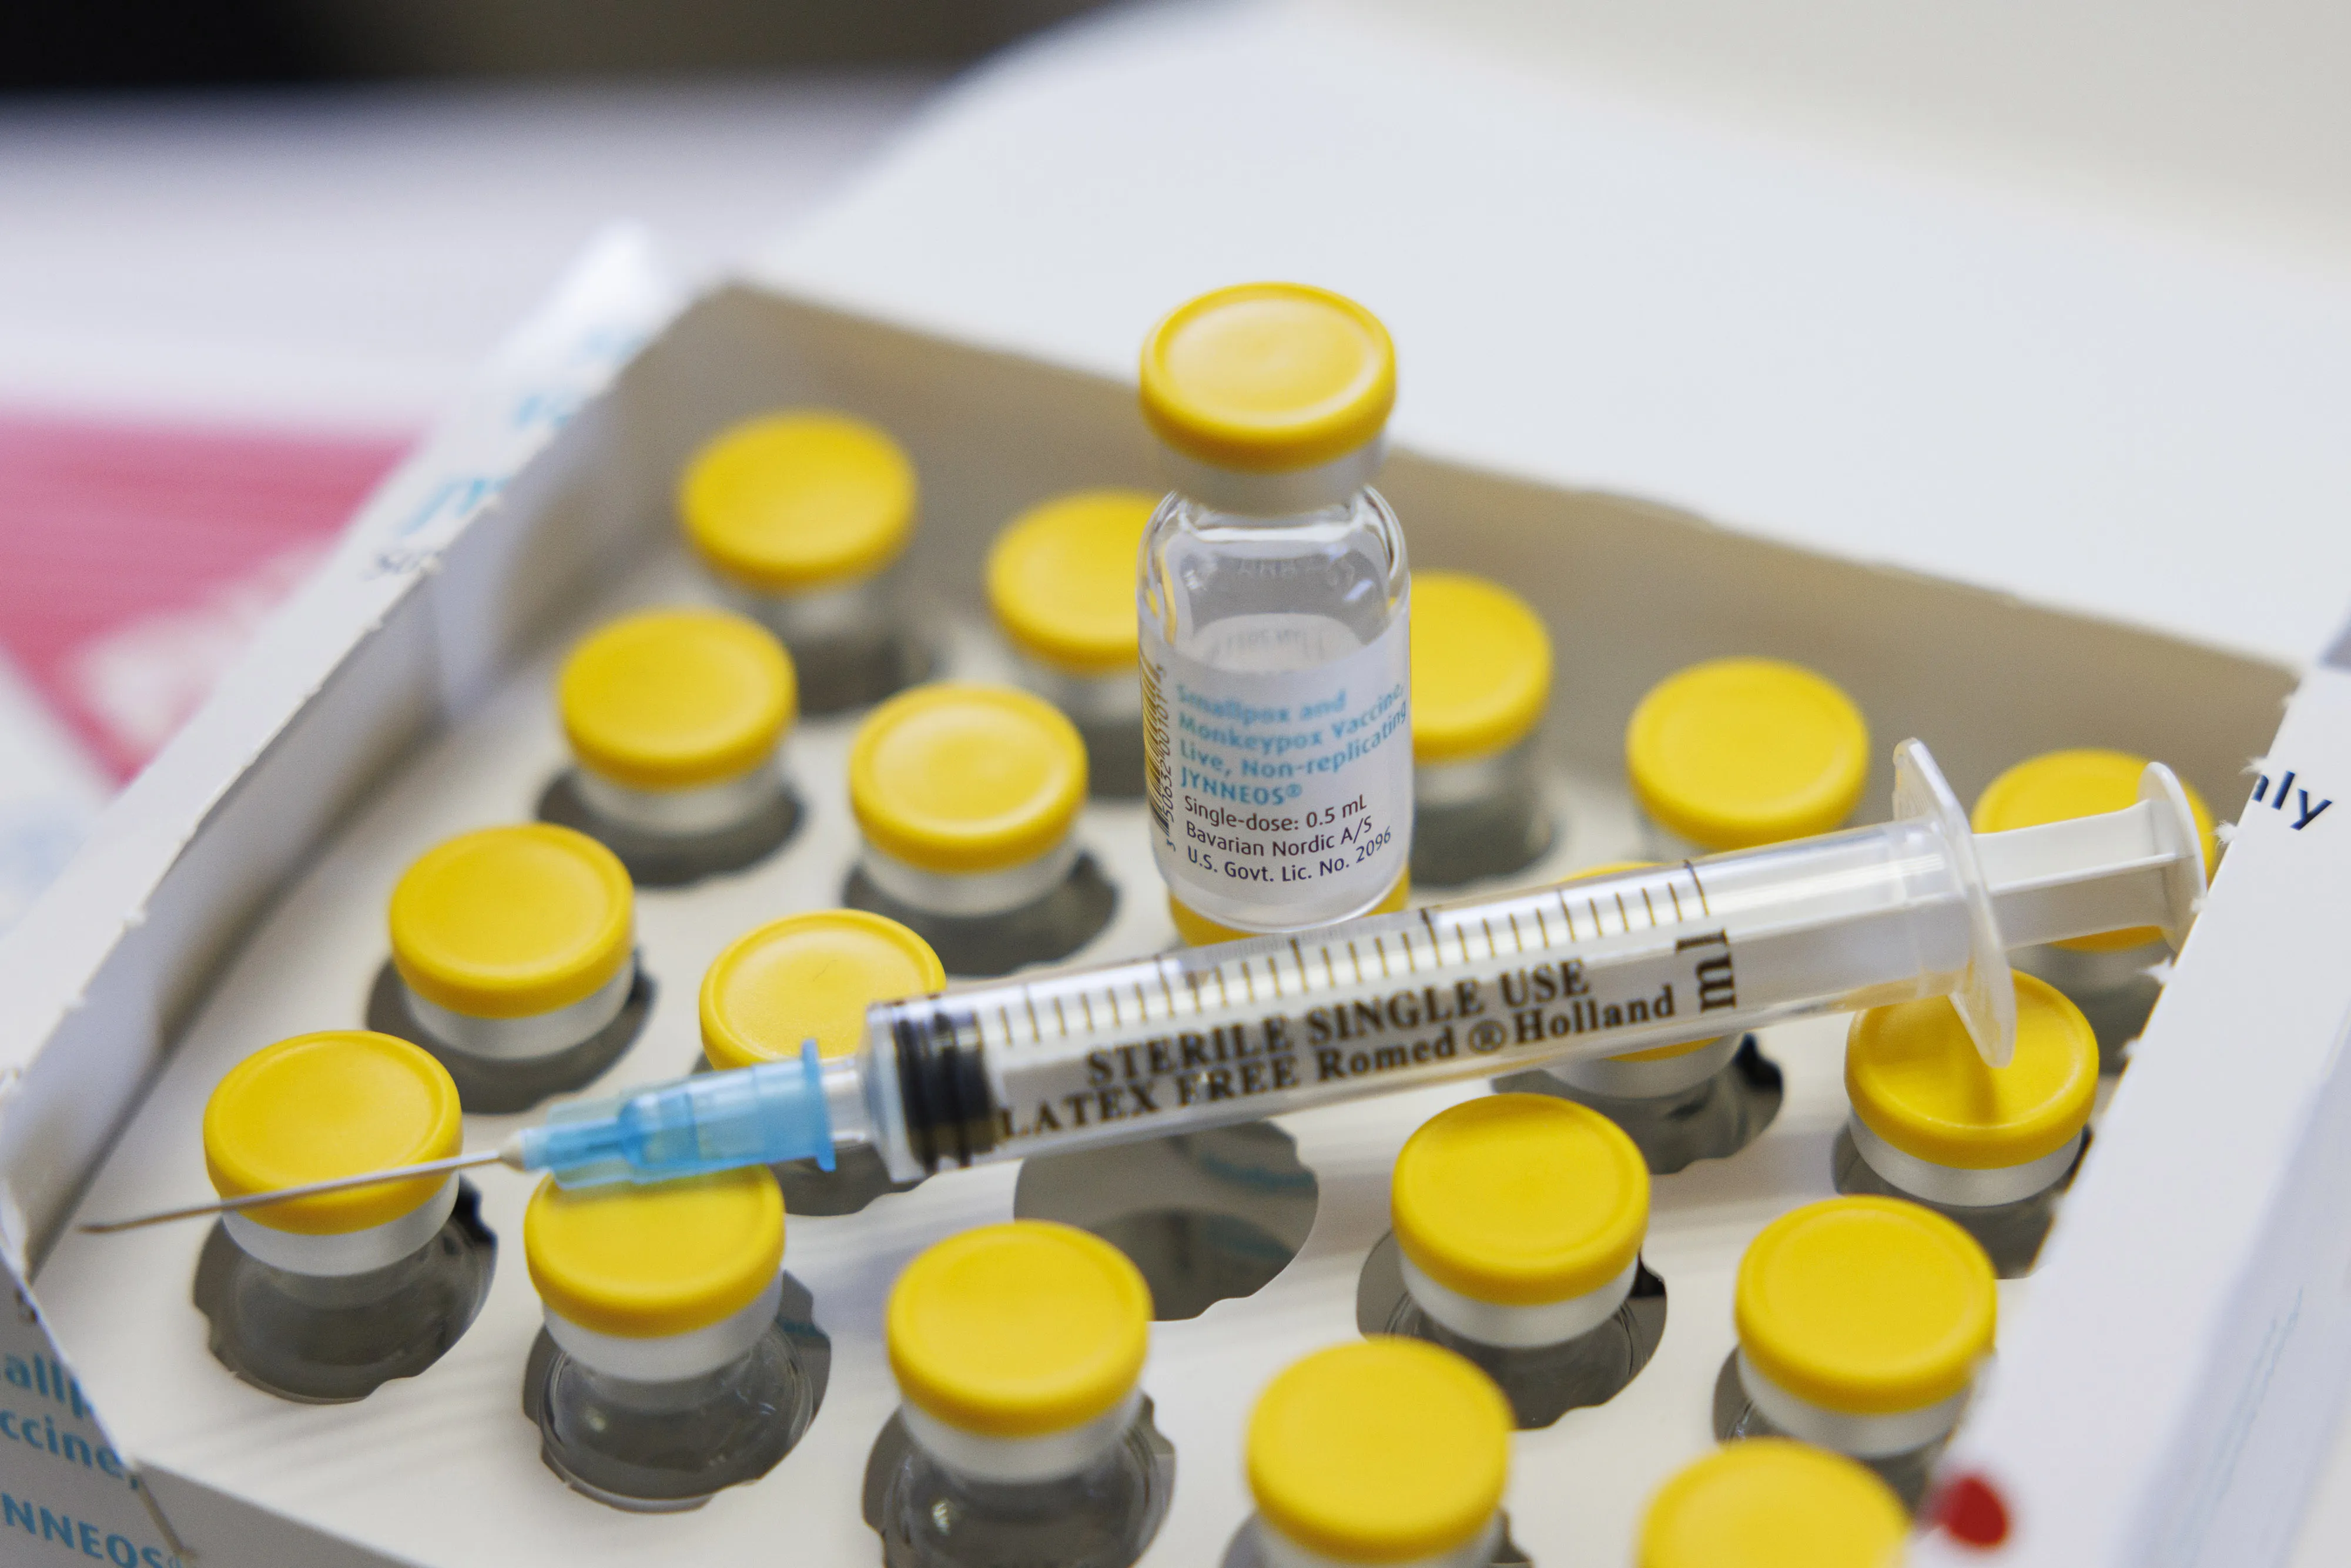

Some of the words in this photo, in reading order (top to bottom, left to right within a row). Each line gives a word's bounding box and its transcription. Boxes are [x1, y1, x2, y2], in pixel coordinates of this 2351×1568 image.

[1177, 685, 1290, 727] Smallpox
[1300, 689, 1347, 721] and
[1179, 712, 1322, 755] Monkeypox
[1180, 739, 1232, 778] Live,
[1242, 701, 1406, 778] Non-replicating
[1184, 795, 1299, 832] Single-dose:
[1306, 806, 1335, 828] 0.5
[1342, 794, 1367, 819] mL
[1186, 820, 1264, 857] Bavarian
[1272, 834, 1335, 857] Nordic
[1341, 815, 1372, 845] A/S
[1187, 845, 1218, 873] U.S.
[1224, 861, 1274, 882] Govt.
[1282, 864, 1312, 882] Lic.
[1319, 858, 1349, 877] No.
[1355, 825, 1391, 863] 2096
[1675, 927, 1737, 1013] ml
[1087, 1013, 1293, 1087] STERILE
[1306, 977, 1486, 1046] SINGLE
[1499, 957, 1589, 1008] USE
[1000, 1081, 1161, 1139] LATEX
[1176, 1054, 1300, 1107] FREE
[1316, 1025, 1456, 1083] Romed
